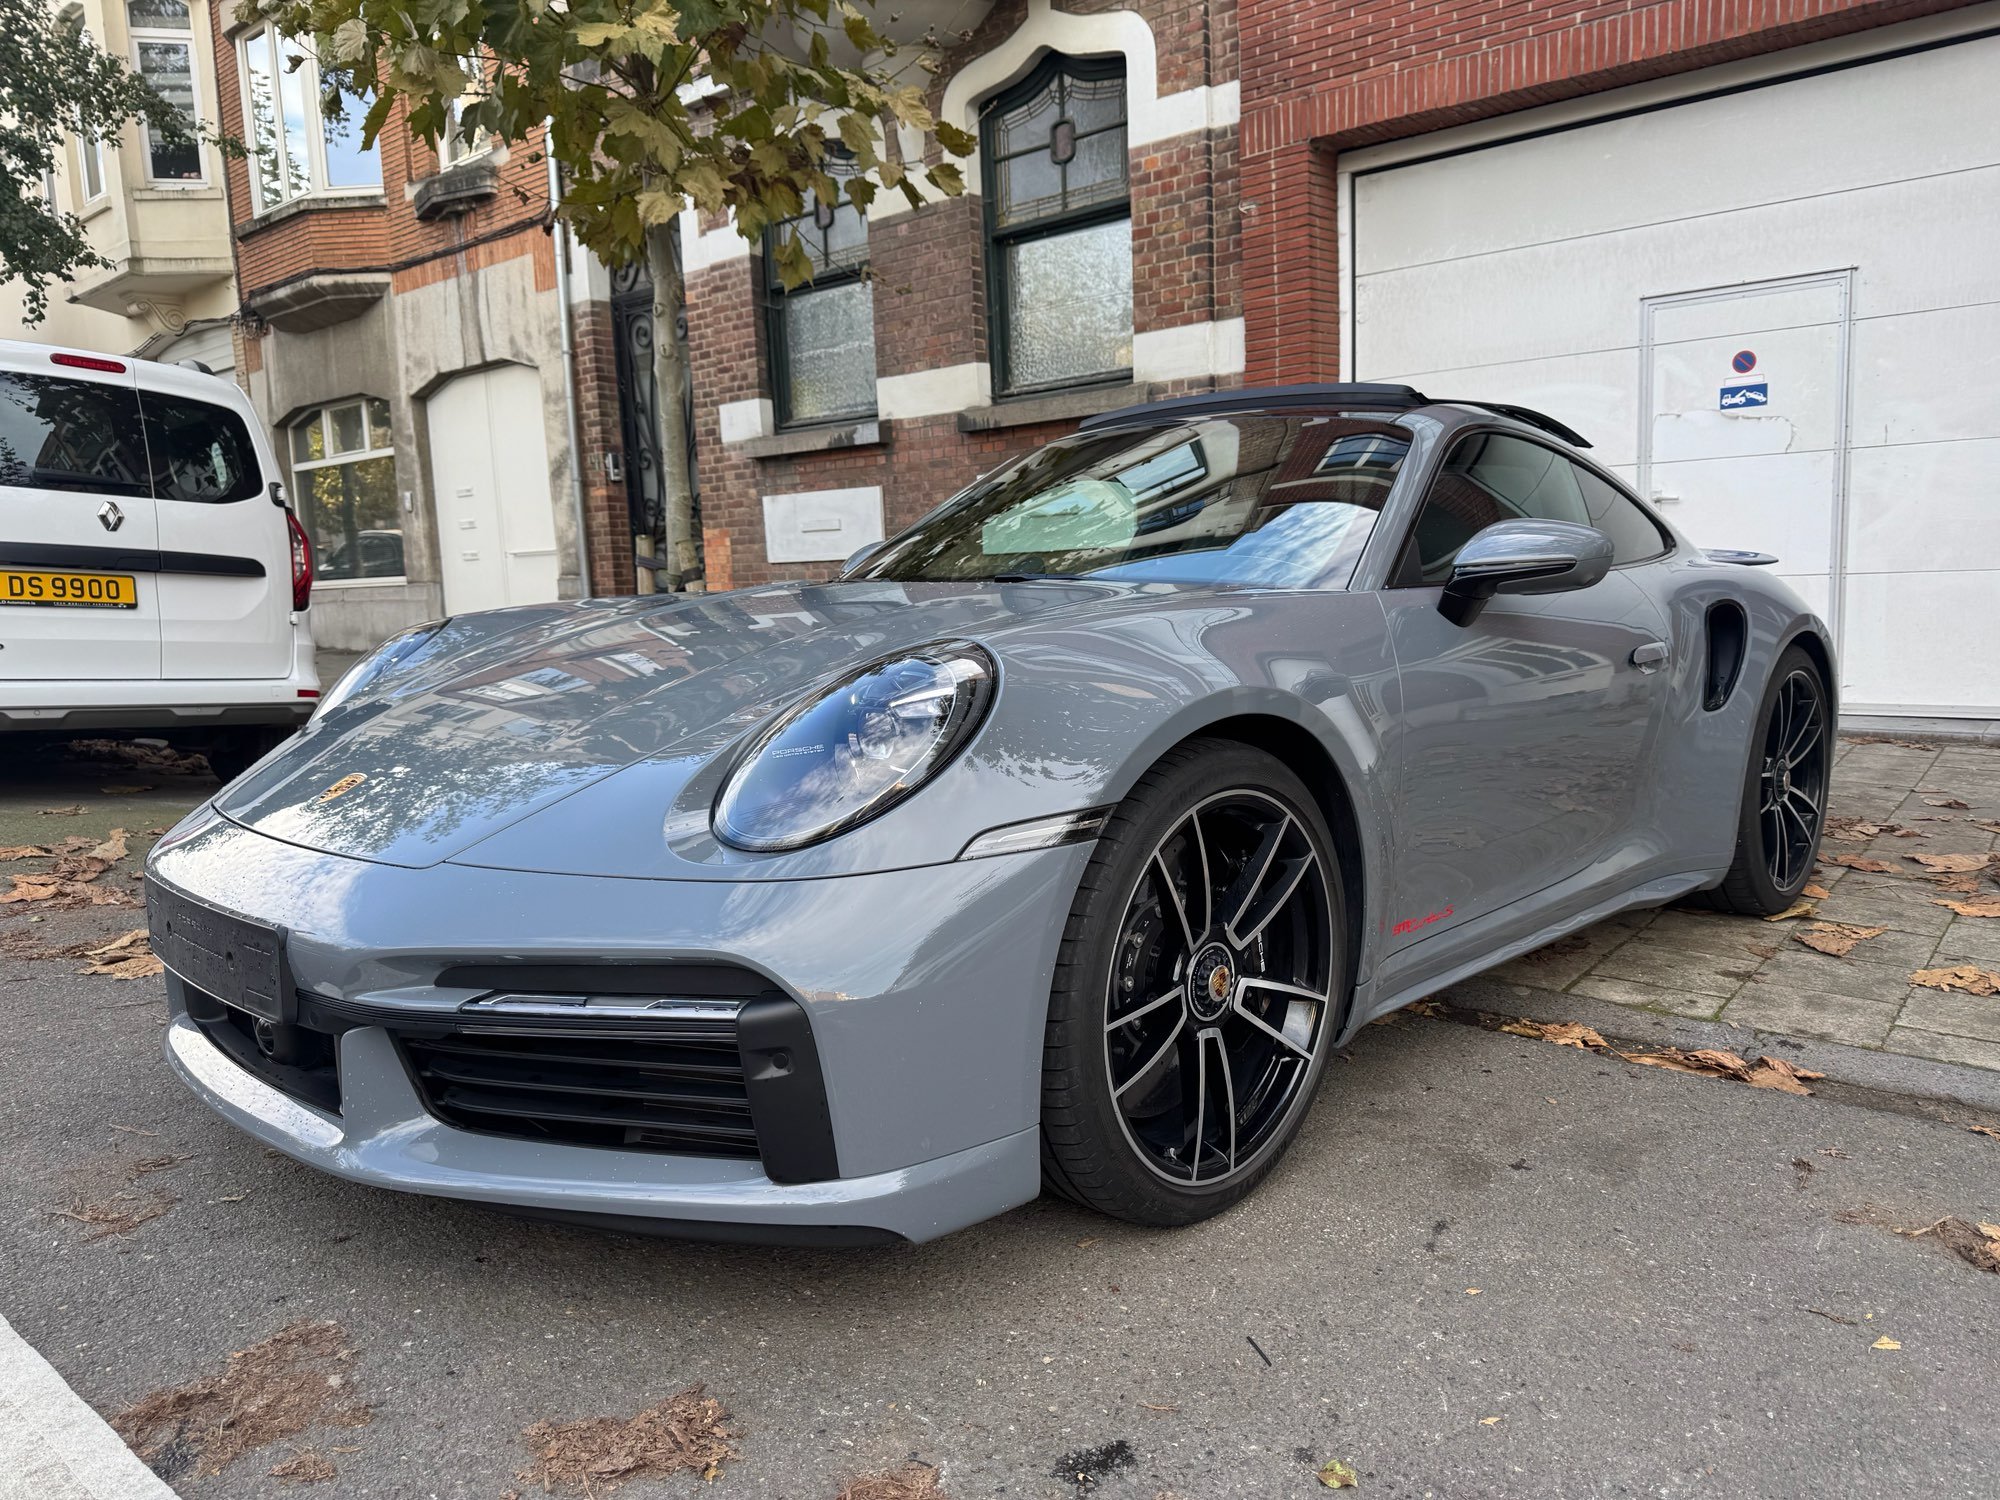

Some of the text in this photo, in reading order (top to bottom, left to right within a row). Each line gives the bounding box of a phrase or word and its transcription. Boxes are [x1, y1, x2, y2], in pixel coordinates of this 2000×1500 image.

[8, 575, 120, 600] DS 9900
[772, 744, 825, 755] PORSCHE
